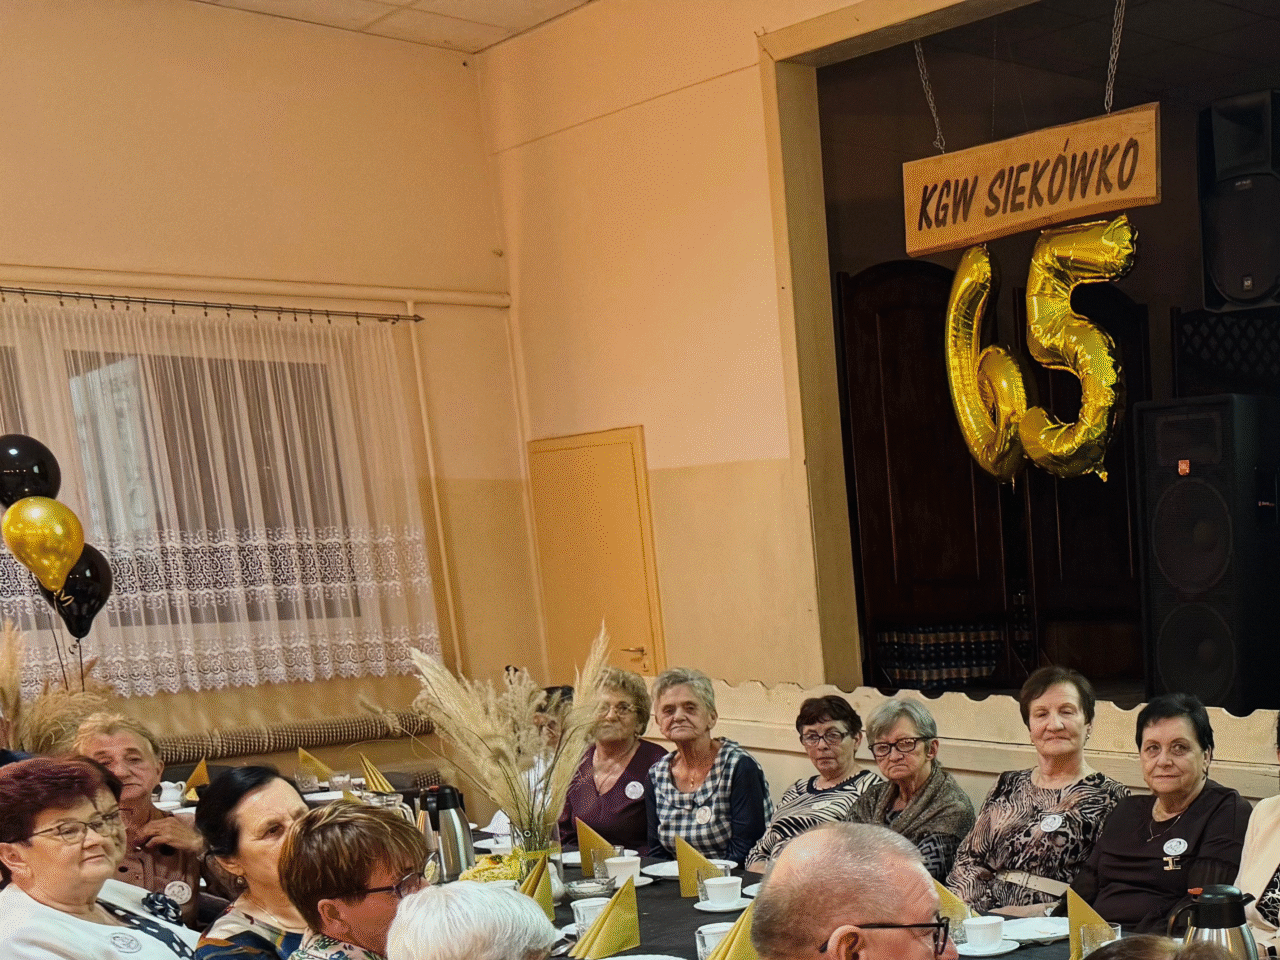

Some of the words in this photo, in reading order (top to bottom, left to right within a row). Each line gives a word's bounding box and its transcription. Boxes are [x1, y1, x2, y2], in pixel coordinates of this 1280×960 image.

[918, 175, 978, 231] KGW
[984, 137, 1139, 218] SIEKÓWKO
[945, 213, 1138, 484] 65
